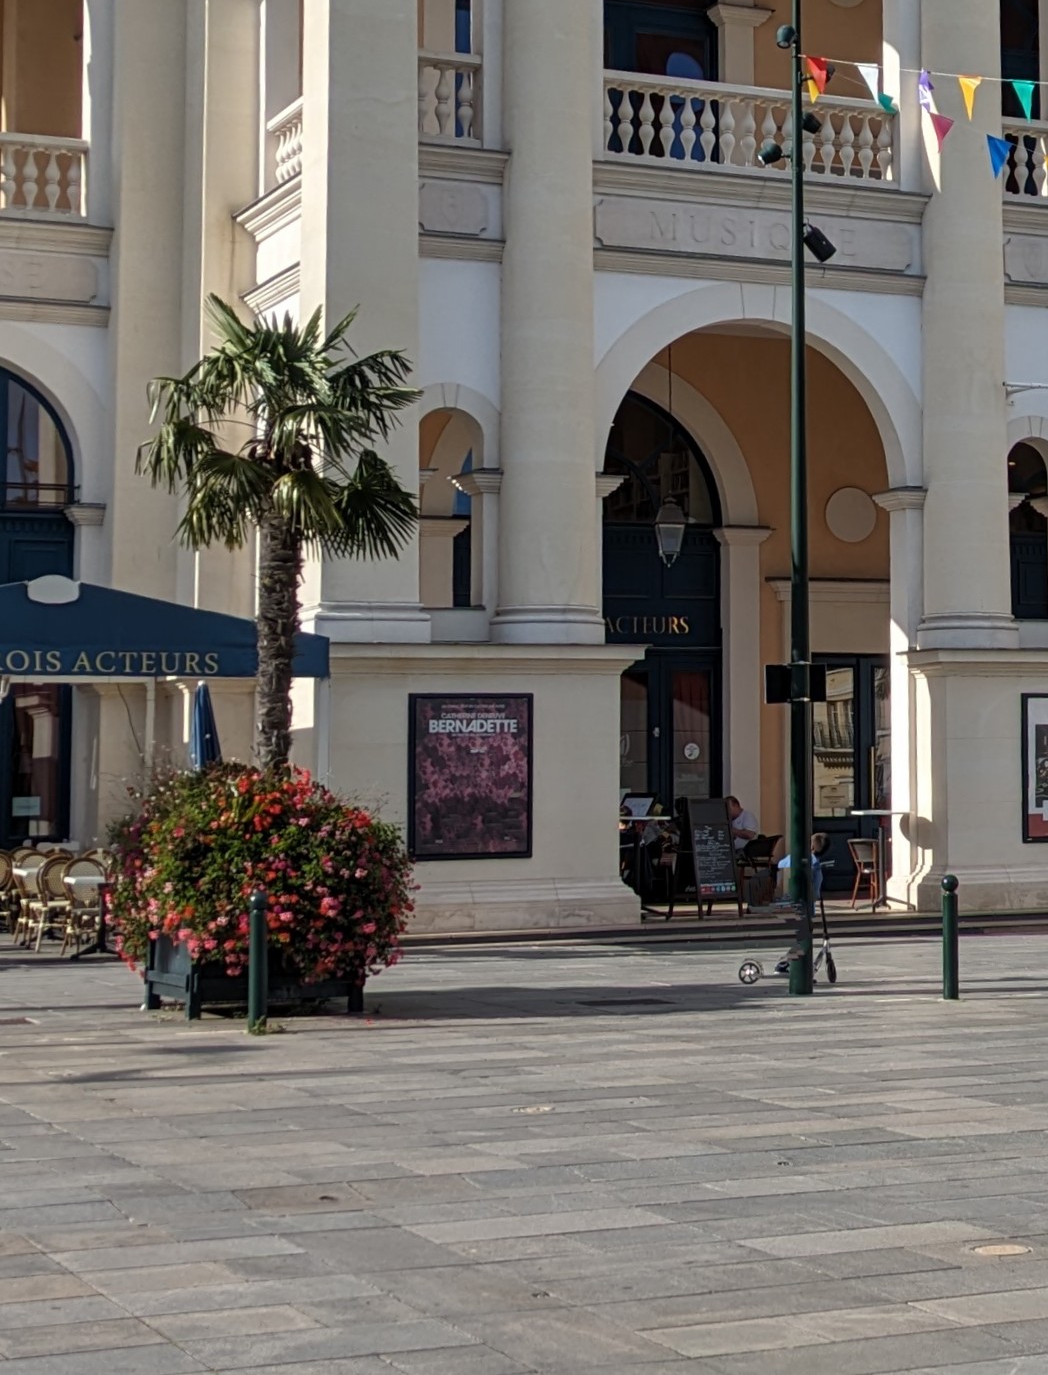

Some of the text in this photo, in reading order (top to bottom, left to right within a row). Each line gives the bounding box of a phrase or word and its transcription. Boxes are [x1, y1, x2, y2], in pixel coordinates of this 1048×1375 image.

[650, 210, 856, 257] MUSIQE
[0, 650, 219, 674] OIS ACTEURS
[428, 719, 518, 734] BERNADETTE
